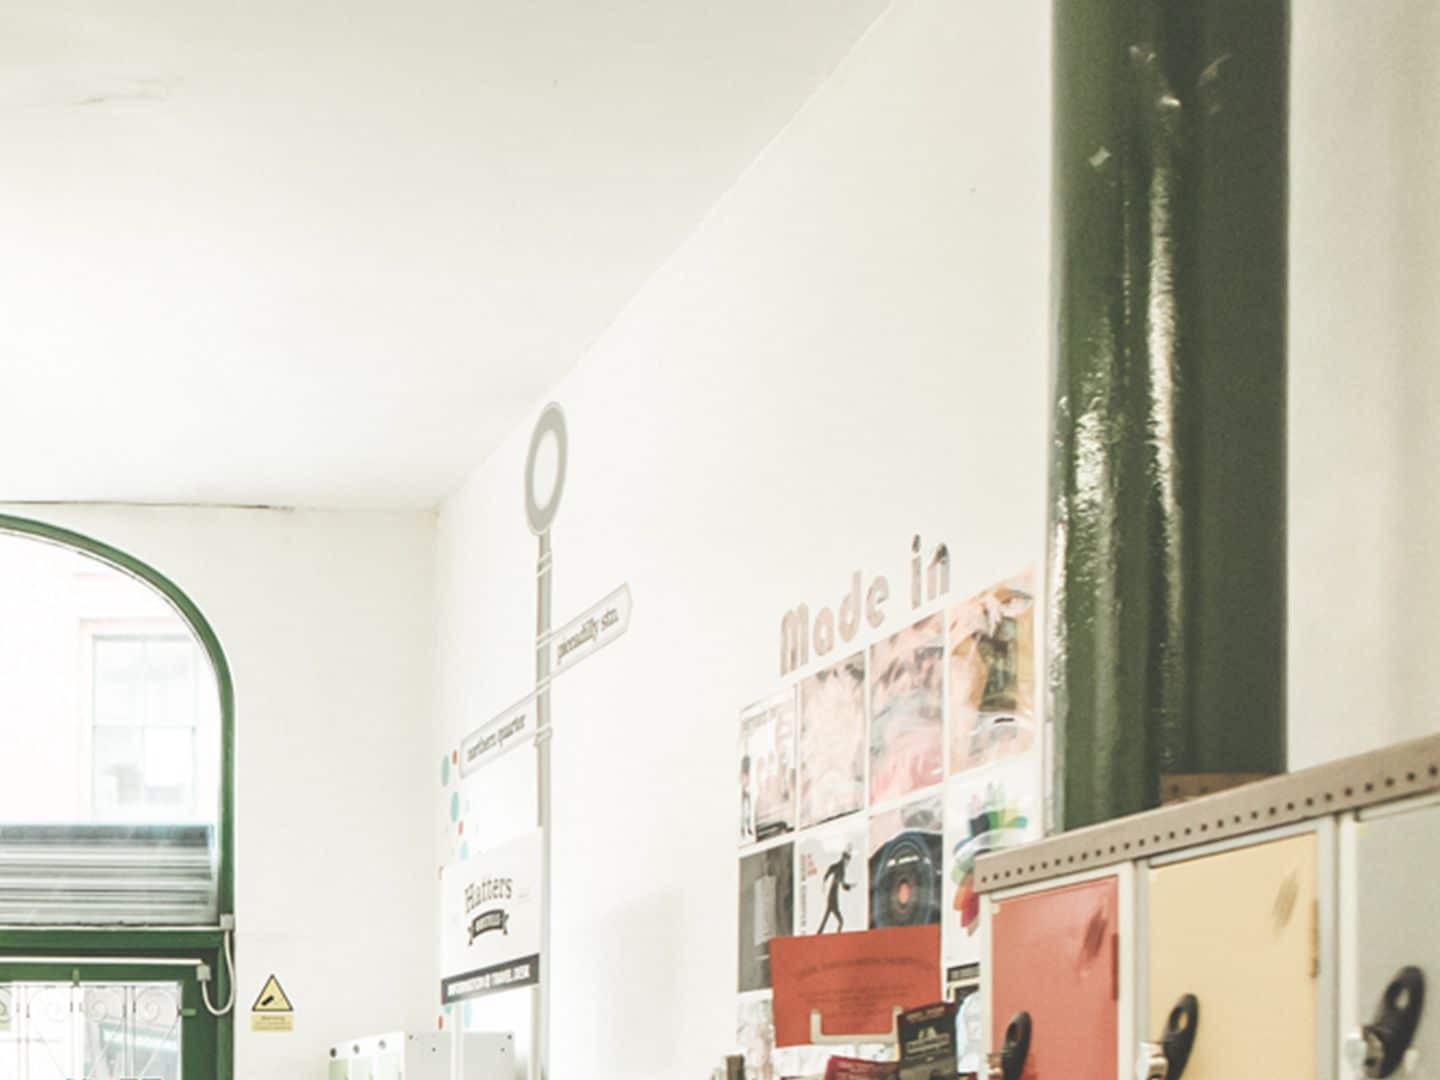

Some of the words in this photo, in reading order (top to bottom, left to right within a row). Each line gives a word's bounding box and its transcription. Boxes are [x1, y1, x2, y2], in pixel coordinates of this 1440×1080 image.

[779, 570, 889, 678] Made
[911, 533, 951, 611] in
[464, 877, 513, 914] Hatters
